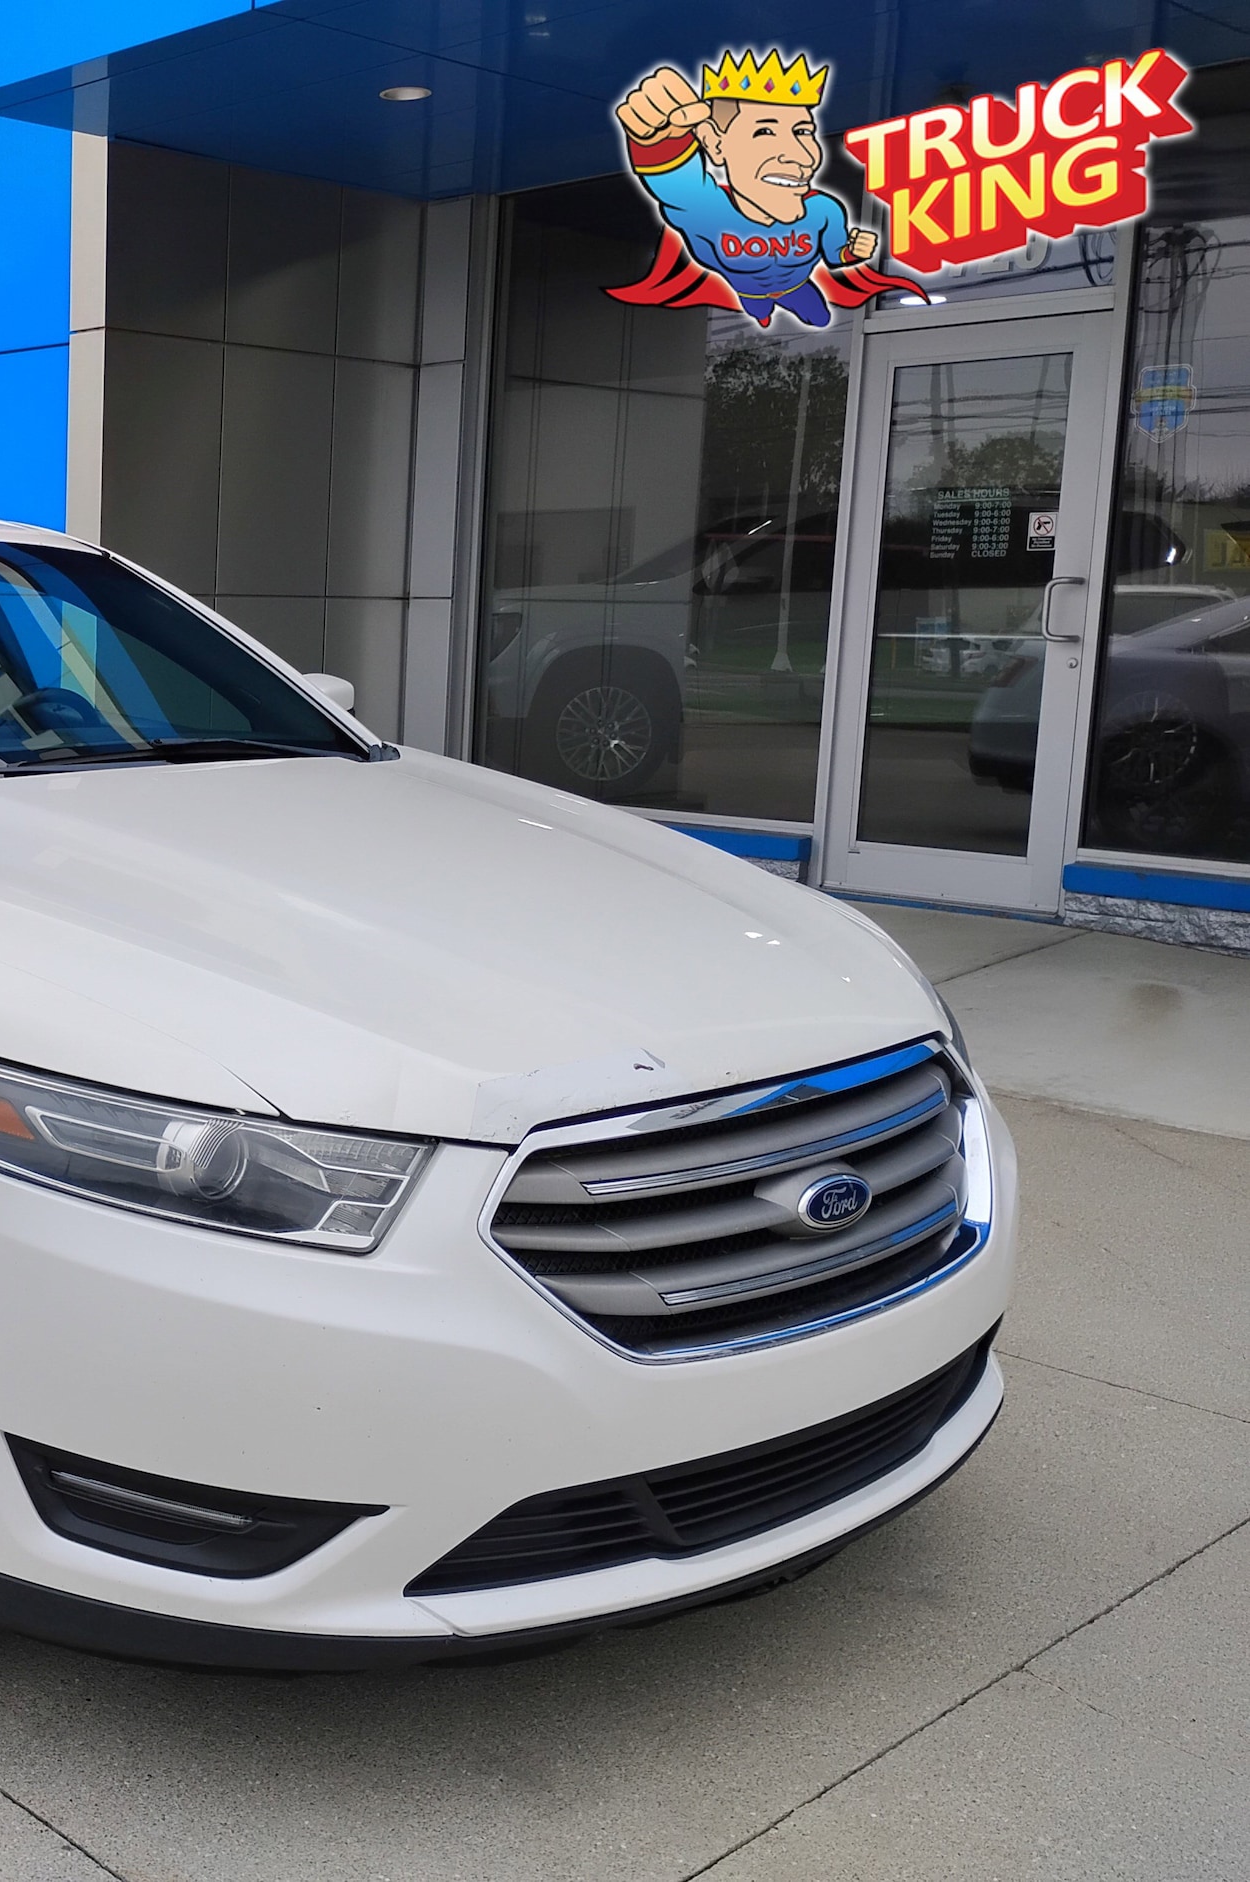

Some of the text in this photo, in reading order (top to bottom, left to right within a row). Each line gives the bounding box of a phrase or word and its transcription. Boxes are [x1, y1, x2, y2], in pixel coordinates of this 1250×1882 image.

[937, 487, 1010, 500] SALES HOURS
[974, 501, 1012, 509] 9:00-7:00
[974, 509, 1011, 518] 9:00-6:00
[973, 517, 1011, 526] 9:00-6:00
[972, 526, 1010, 534] 9:00-7:00
[972, 534, 1010, 542] 9:00-6:00
[971, 542, 1009, 550] 9:00-3:00
[971, 549, 1007, 558] CLOSED
[821, 1186, 859, 1219] Ford
